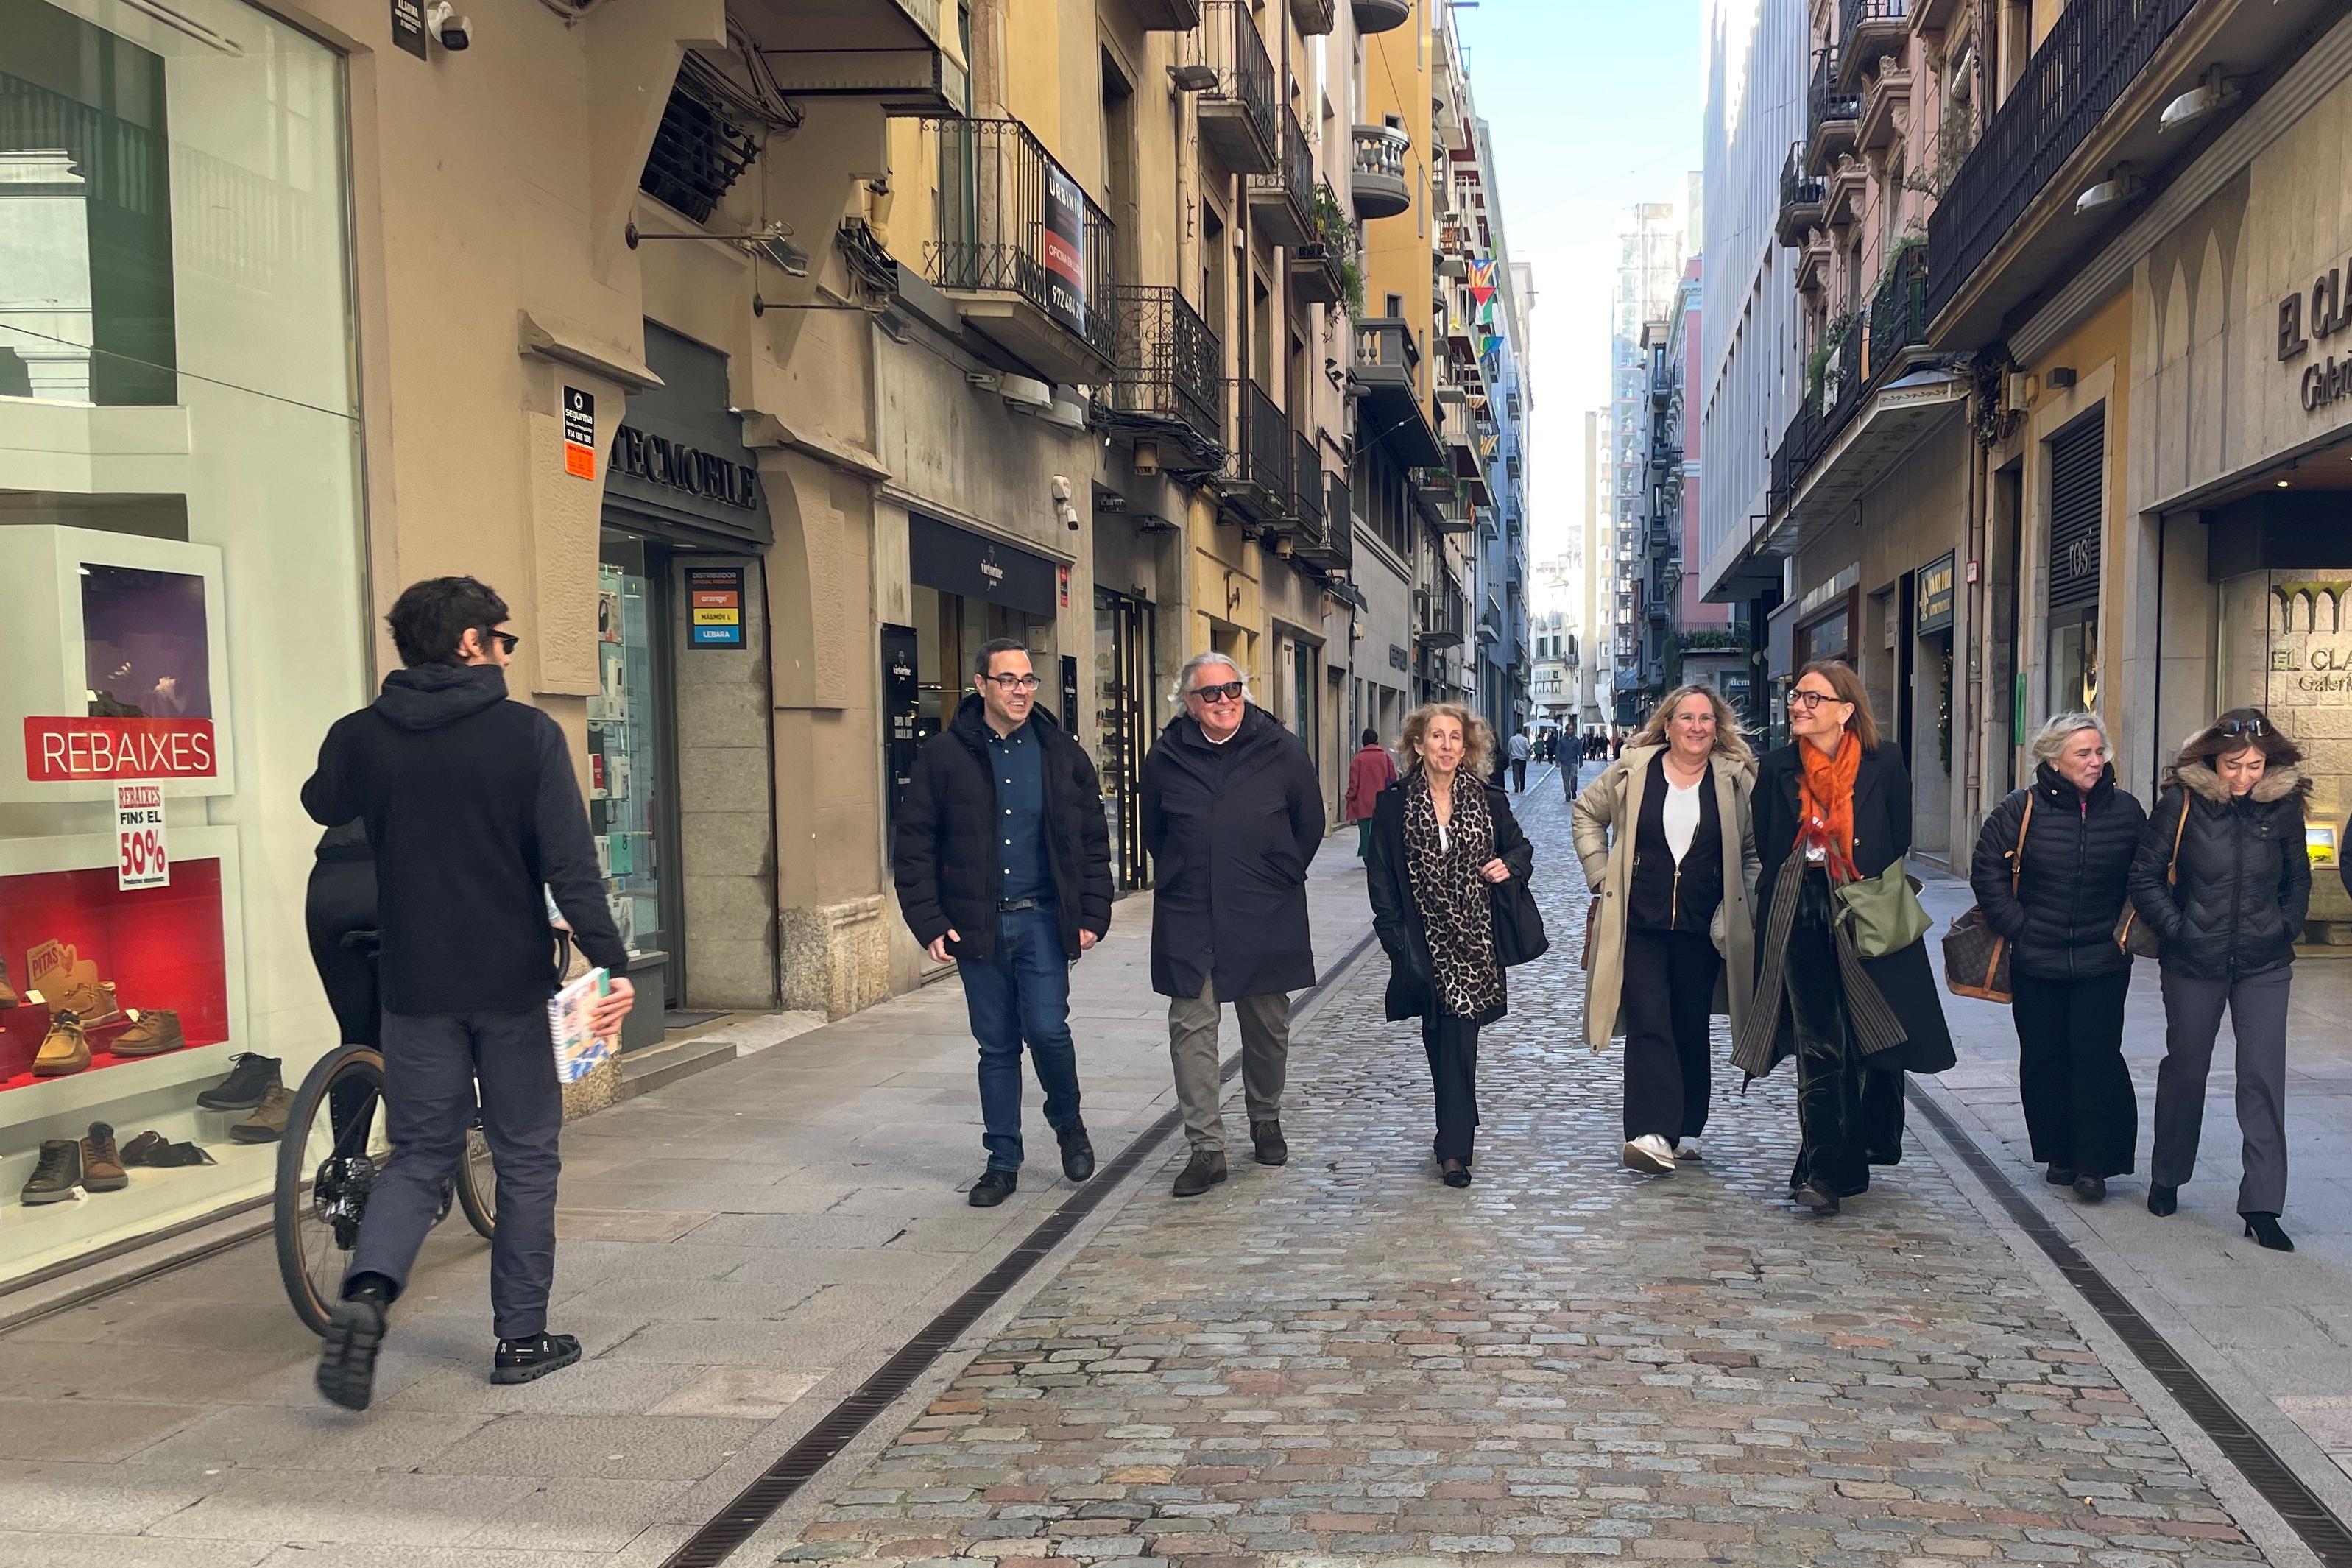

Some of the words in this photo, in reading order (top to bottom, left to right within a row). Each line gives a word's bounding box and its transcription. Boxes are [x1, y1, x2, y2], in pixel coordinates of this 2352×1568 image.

[1053, 285, 1064, 308] 972
[2278, 292, 2308, 361] EL
[565, 408, 593, 424] segurma
[701, 595, 727, 604] orange
[702, 630, 730, 638] LEBARA
[2271, 648, 2300, 671] EL
[43, 732, 211, 773] REBAIXES
[119, 786, 161, 808] REBAIXES
[120, 811, 144, 825] FINS
[147, 811, 162, 823] EL
[121, 829, 166, 876] 50%
[32, 947, 59, 978] PITAS
